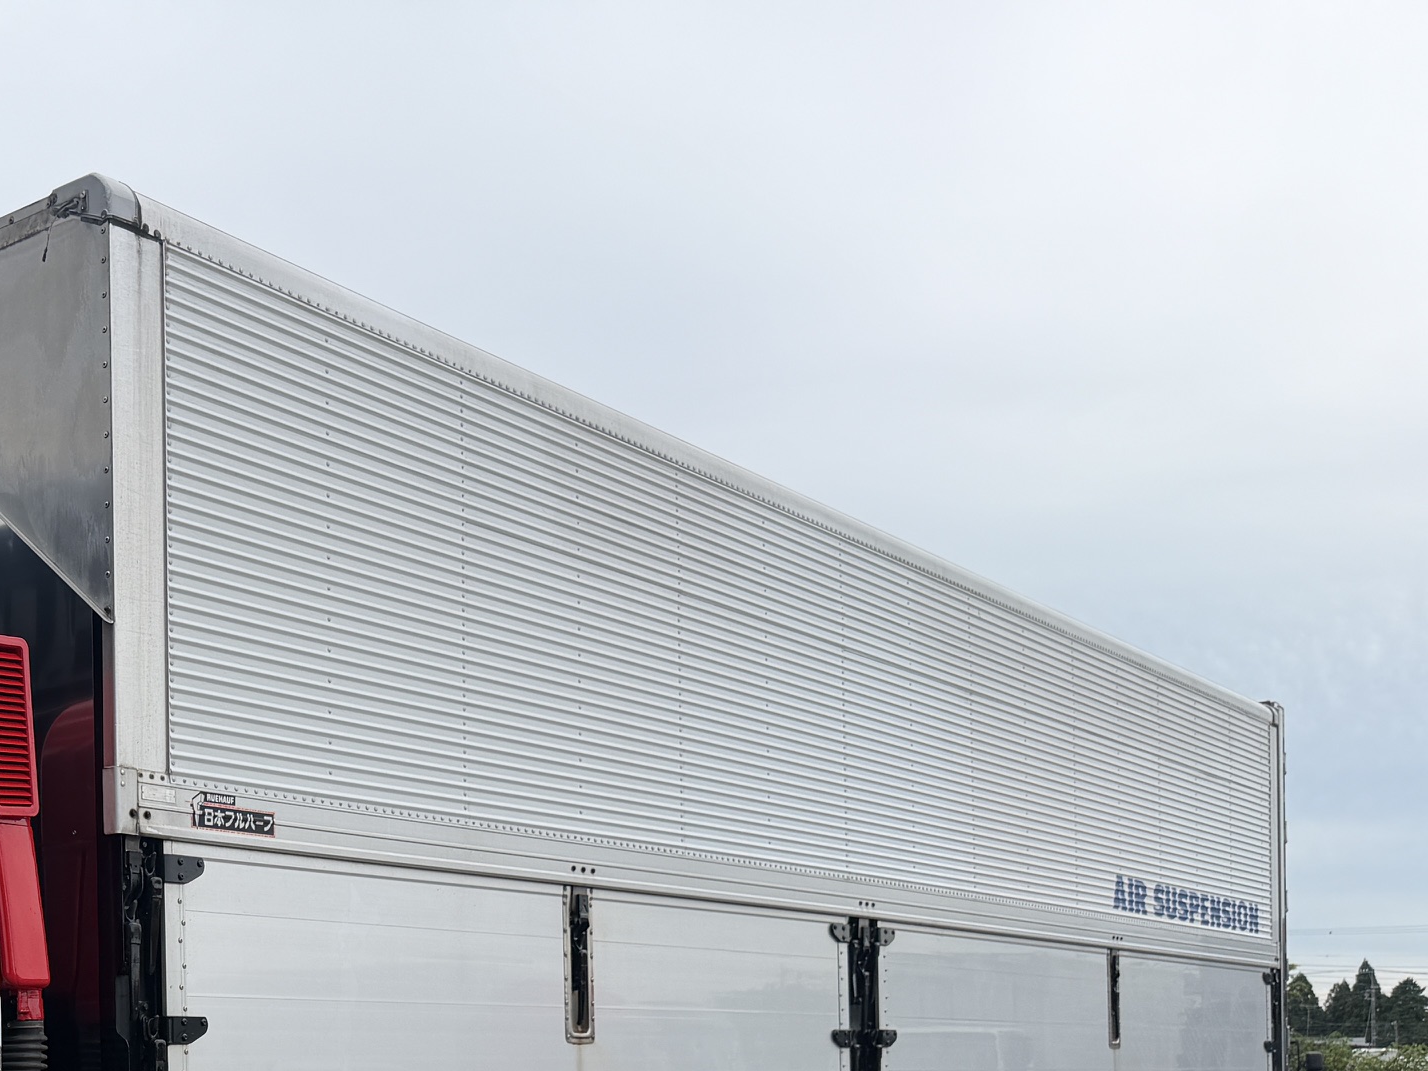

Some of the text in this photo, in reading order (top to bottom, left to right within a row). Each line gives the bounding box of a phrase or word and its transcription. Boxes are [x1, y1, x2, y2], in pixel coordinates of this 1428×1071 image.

[204, 808, 273, 832] 日本フルハーフ
[1113, 874, 1259, 934] AIR SUSPENSION
